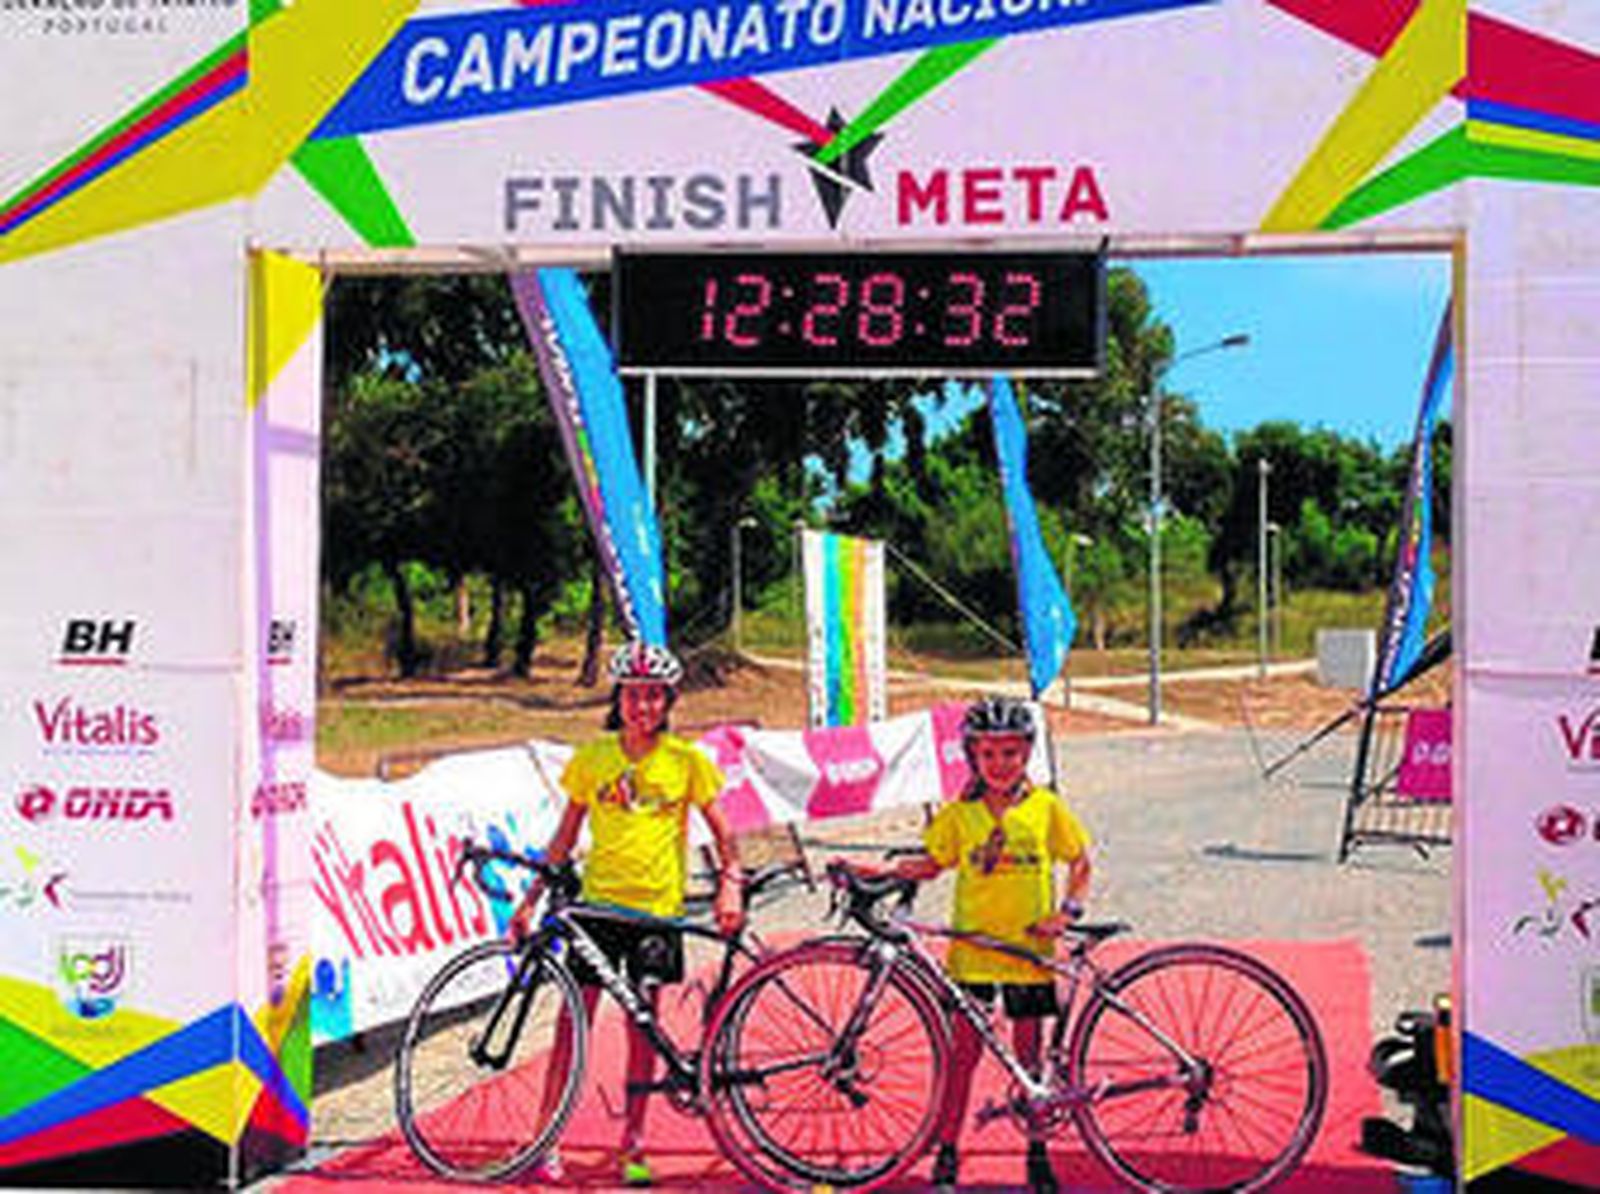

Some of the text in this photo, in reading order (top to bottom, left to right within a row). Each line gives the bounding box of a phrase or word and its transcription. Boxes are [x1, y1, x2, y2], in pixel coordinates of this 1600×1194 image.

[402, 0, 843, 104] CAMPEONATO
[504, 174, 783, 231] FINISH
[897, 168, 1109, 226] META
[702, 272, 1041, 345] 12:28:32
[61, 620, 135, 653] BH
[34, 696, 159, 746] Vitalis
